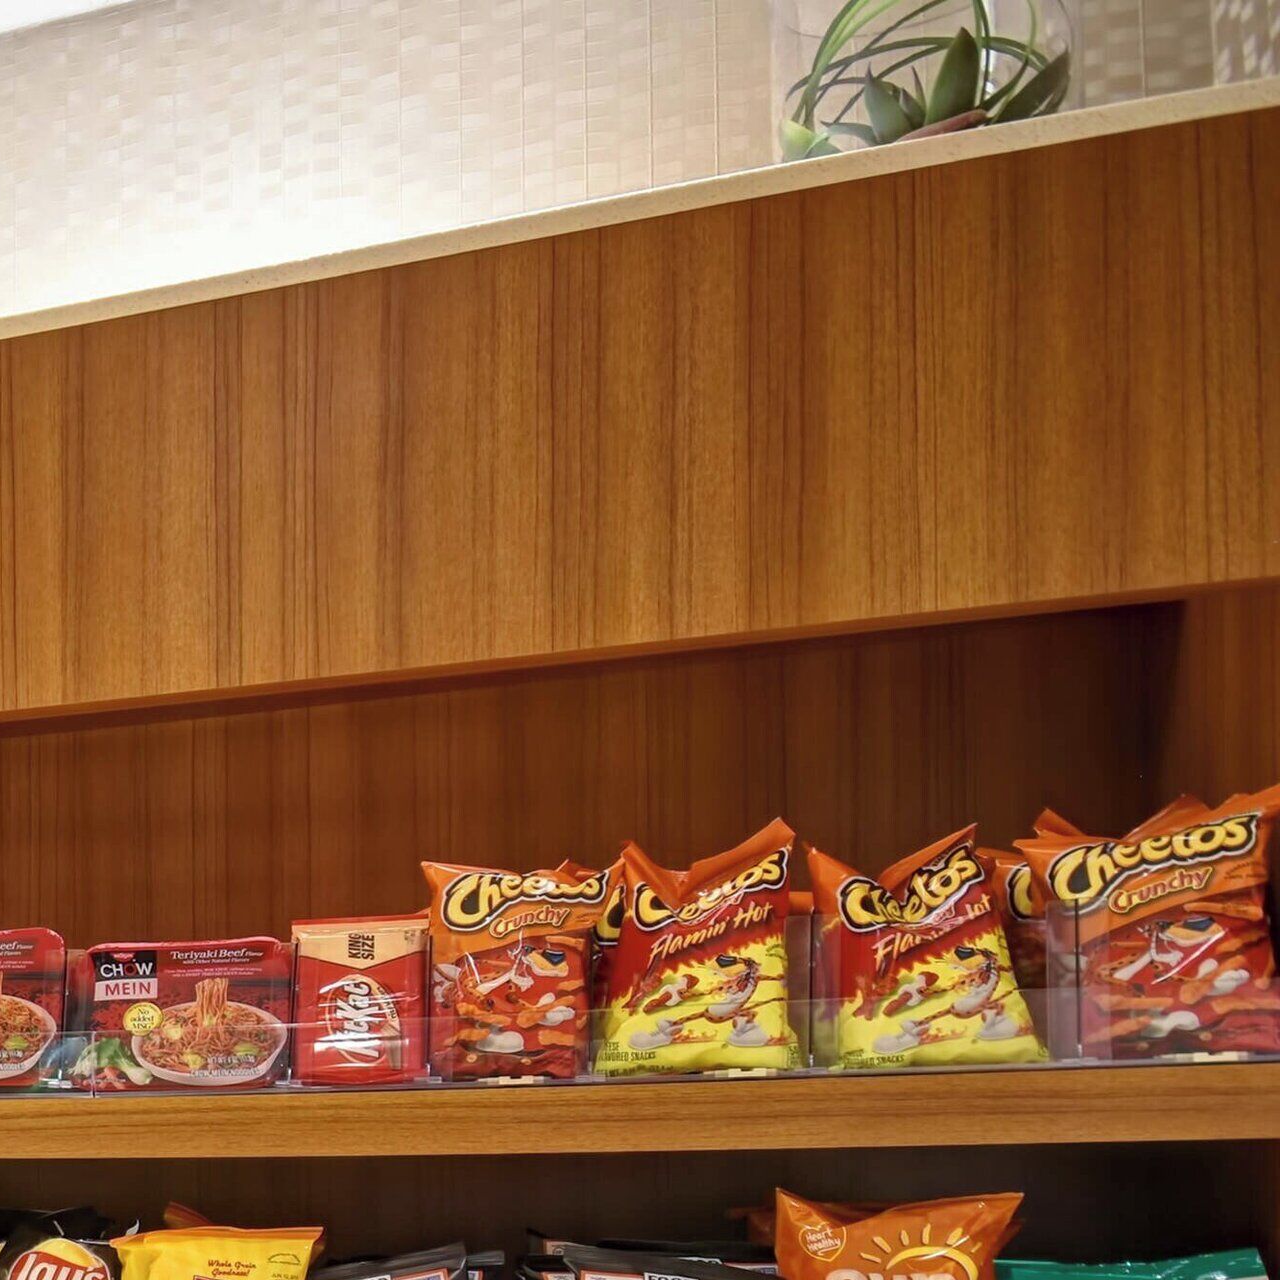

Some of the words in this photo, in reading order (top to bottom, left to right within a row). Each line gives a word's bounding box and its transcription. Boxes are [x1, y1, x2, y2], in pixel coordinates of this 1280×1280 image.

[1049, 814, 1257, 903] Cheetos
[444, 872, 606, 927] Cheetos
[1109, 867, 1213, 914] Crunchy
[490, 905, 569, 938] Crunchy
[650, 918, 728, 964] Flamin'
[733, 901, 773, 929] Hot
[171, 950, 219, 959] Teriyaki
[219, 949, 245, 957] Beef
[348, 933, 361, 959] KING
[361, 934, 375, 960] SIZE
[100, 963, 152, 977] CHOW
[105, 982, 151, 996] MEIN
[805, 1228, 832, 1242] Heart
